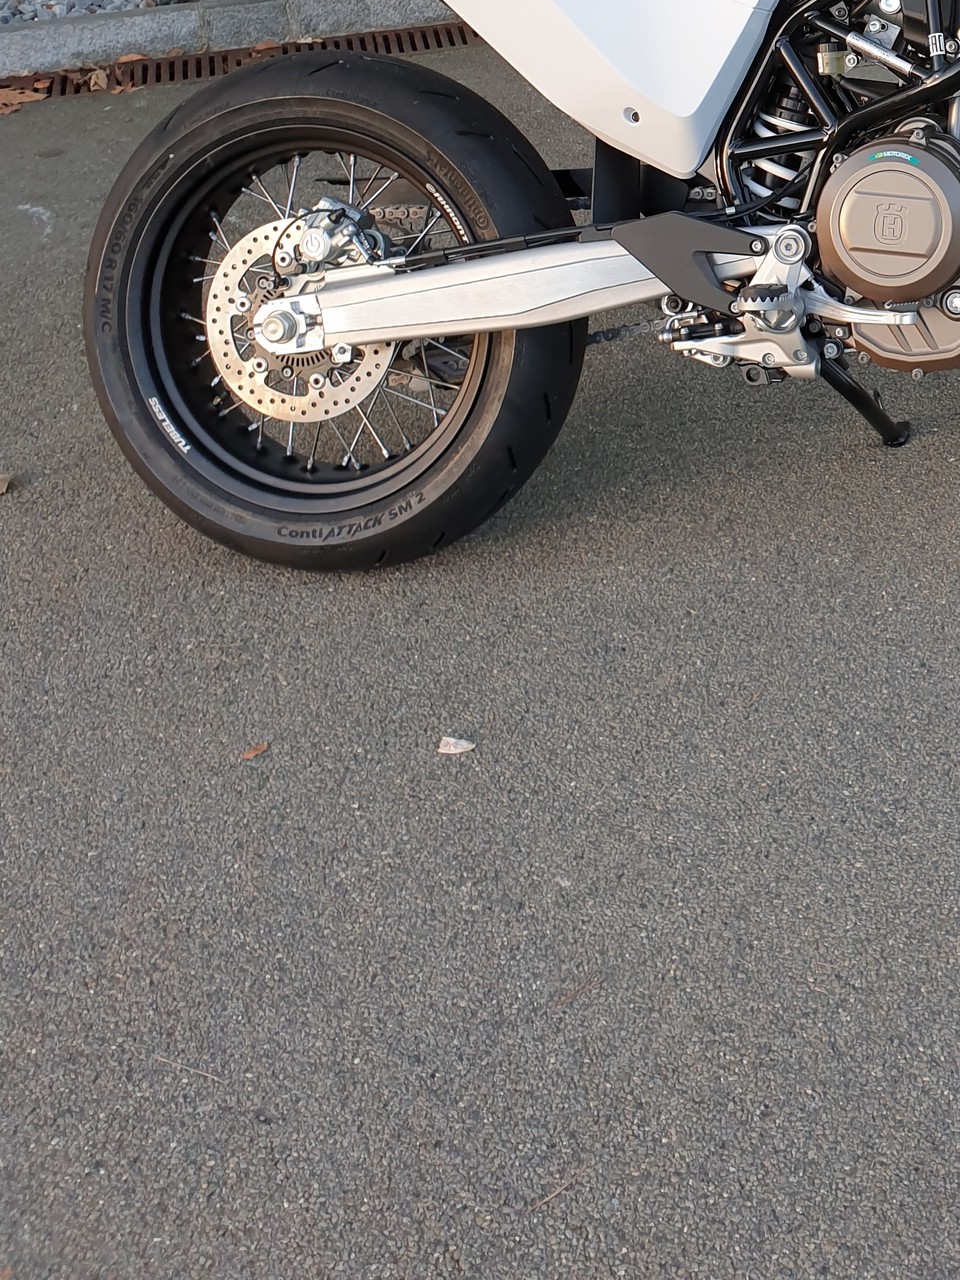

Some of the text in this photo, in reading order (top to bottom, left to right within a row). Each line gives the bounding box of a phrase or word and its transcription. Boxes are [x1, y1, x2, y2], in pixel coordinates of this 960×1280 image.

[149, 396, 191, 454] TUBELESS
[277, 492, 426, 542] ContiATTACK SM 2
